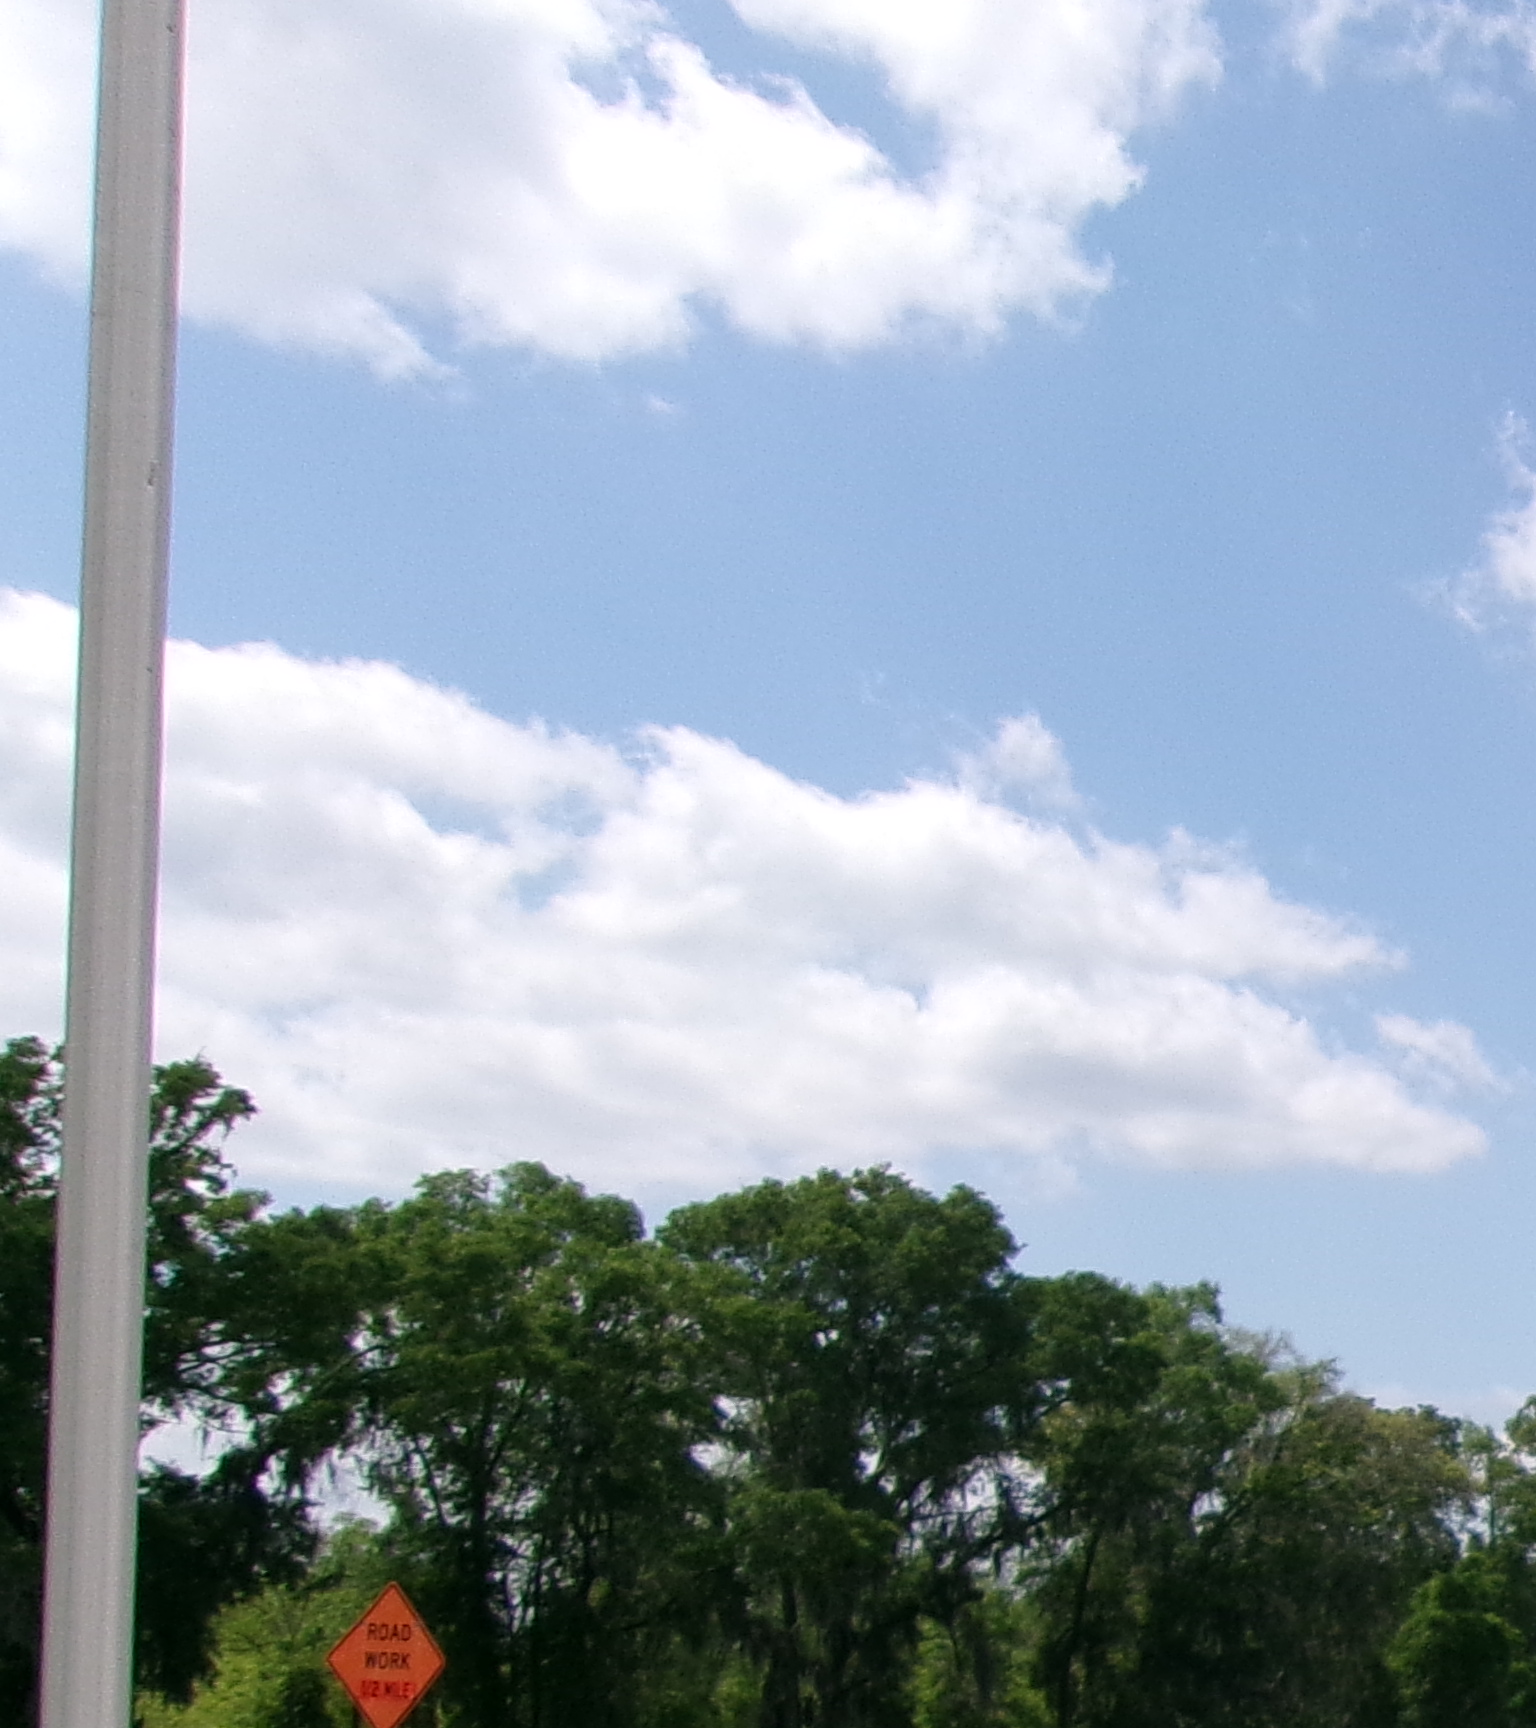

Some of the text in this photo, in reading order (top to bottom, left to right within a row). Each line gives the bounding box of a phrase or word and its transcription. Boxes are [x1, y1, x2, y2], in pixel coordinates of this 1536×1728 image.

[368, 1623, 411, 1641] ROAD
[365, 1652, 410, 1669] WORK
[384, 1681, 410, 1698] MILE
